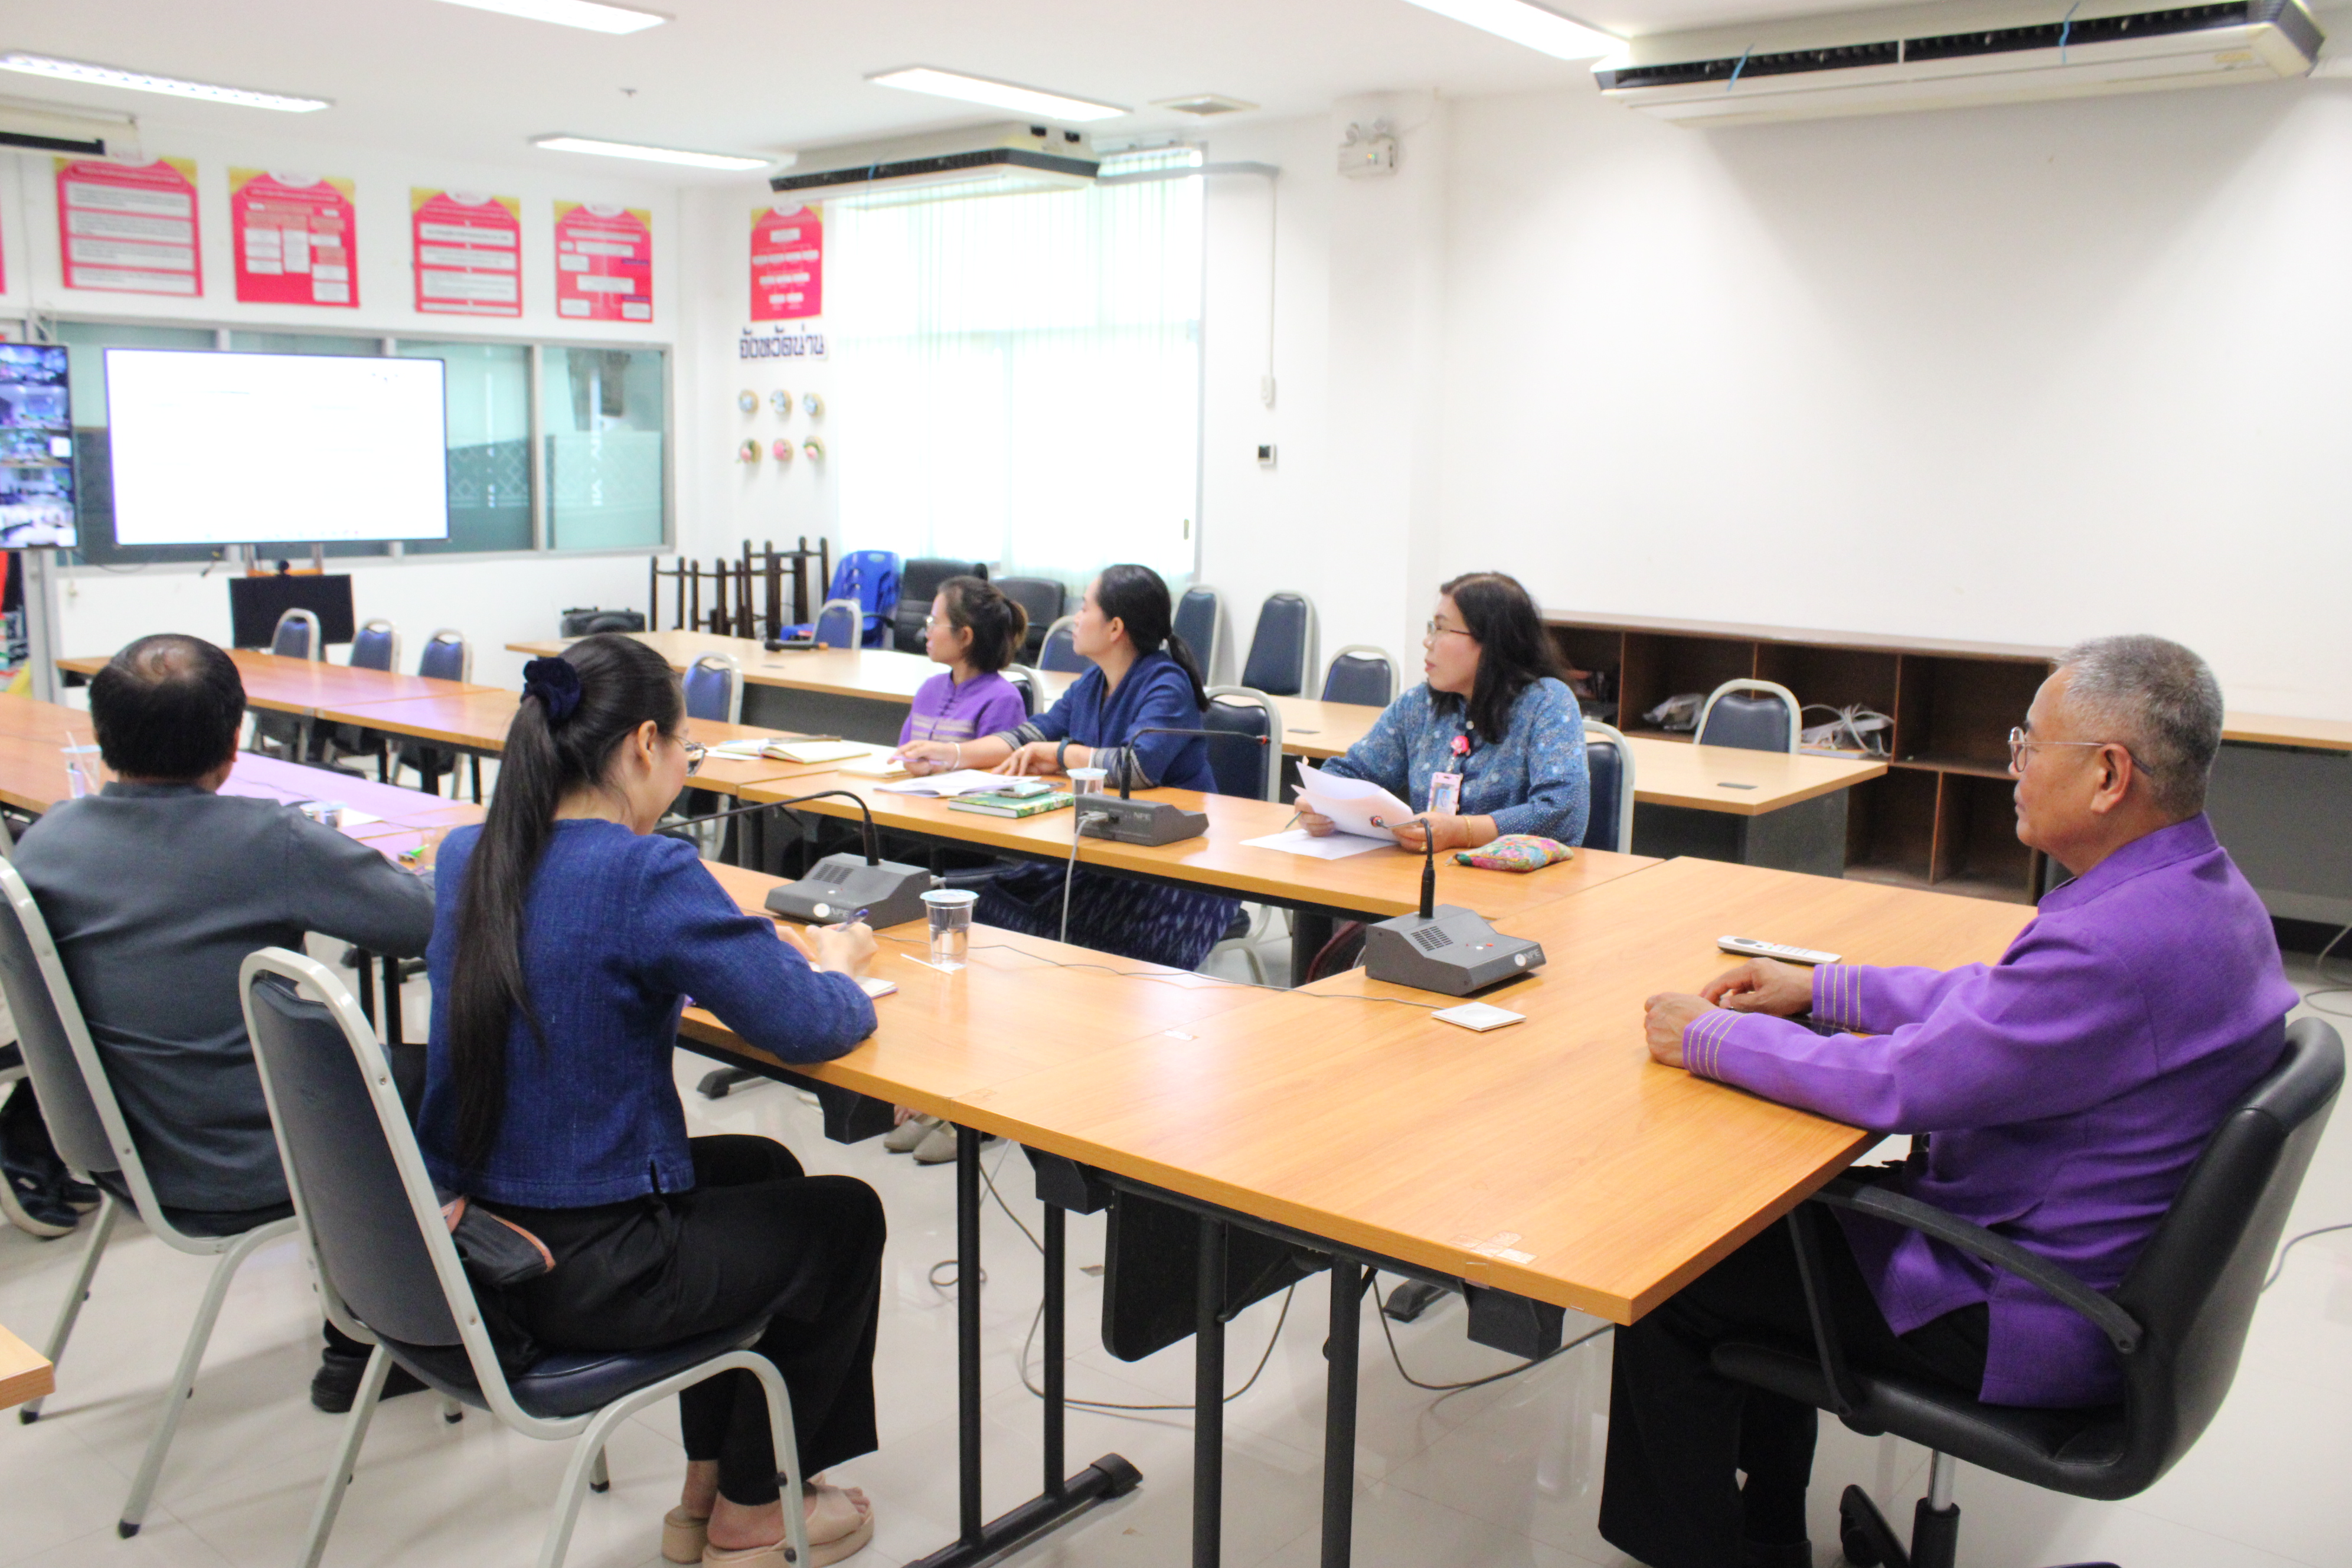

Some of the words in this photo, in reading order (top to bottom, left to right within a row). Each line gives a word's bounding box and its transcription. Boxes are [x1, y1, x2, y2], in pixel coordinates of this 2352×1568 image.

[740, 323, 824, 359] จังหวัดน่าน
